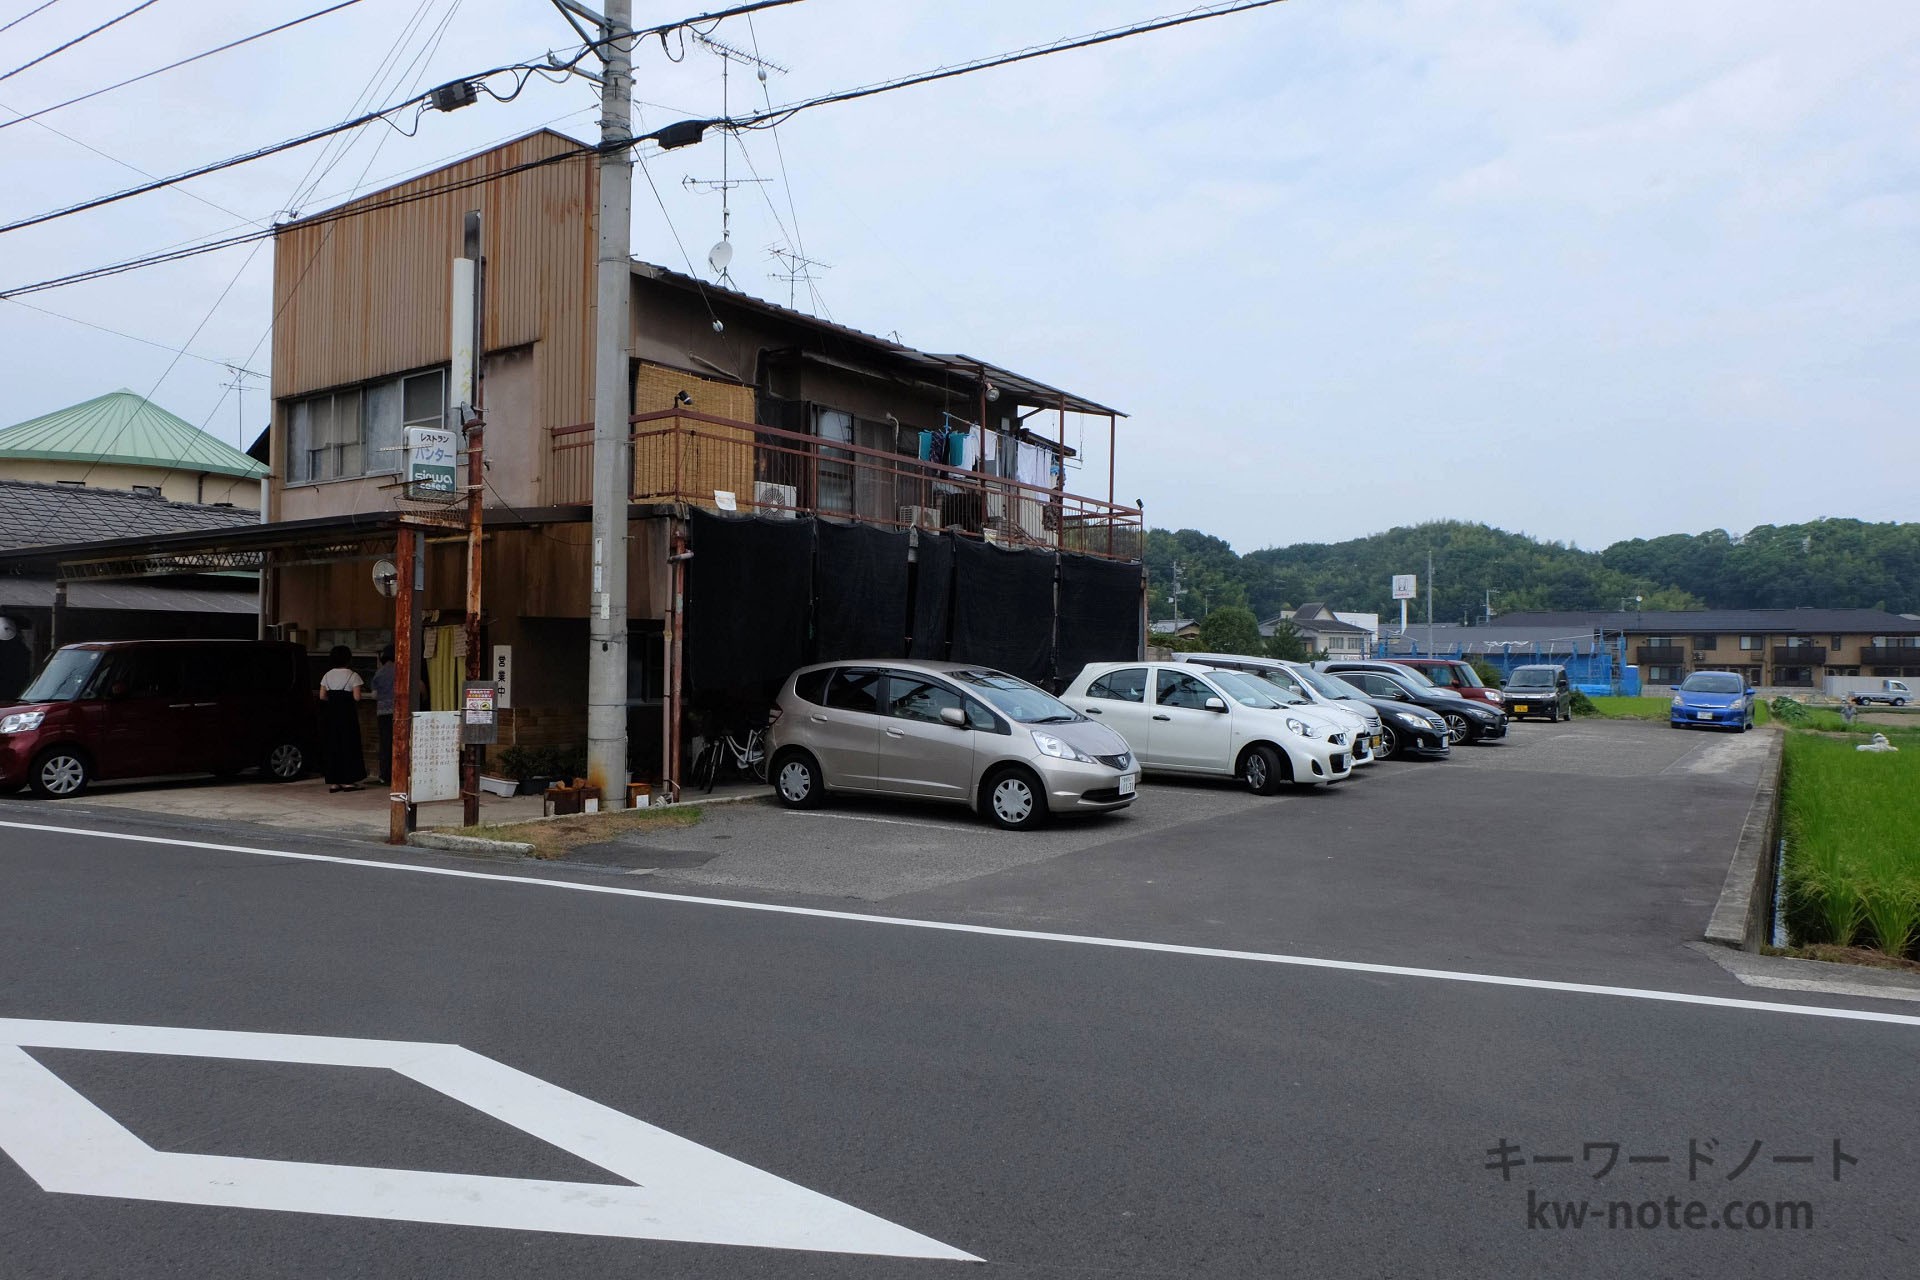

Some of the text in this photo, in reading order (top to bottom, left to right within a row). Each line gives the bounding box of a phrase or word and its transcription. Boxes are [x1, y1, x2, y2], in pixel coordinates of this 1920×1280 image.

[421, 433, 449, 443] レストラン
[497, 655, 506, 698] 営業中
